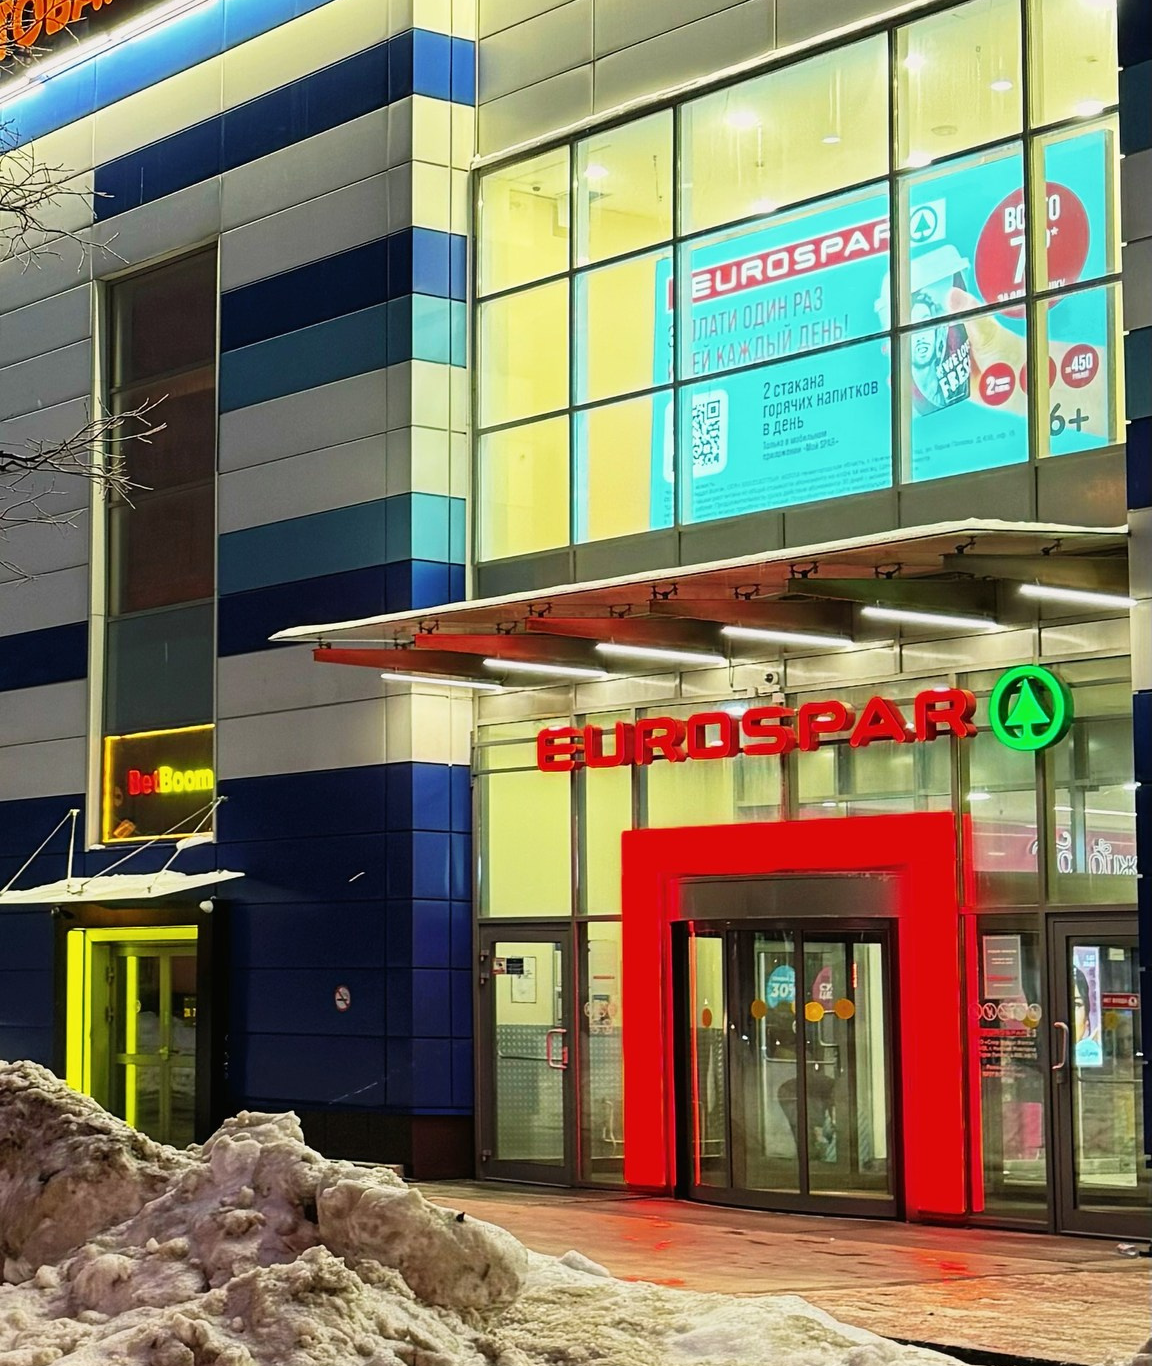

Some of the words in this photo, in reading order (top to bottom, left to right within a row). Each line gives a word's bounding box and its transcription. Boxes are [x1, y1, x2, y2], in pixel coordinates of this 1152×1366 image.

[743, 299, 788, 330] ОДИН
[793, 286, 824, 318] РАЗ
[716, 324, 792, 365] КАЖДЫЙ
[799, 314, 849, 351] ДЕНЬ!
[1071, 352, 1094, 372] 450
[763, 381, 771, 400] 2
[774, 373, 825, 398] стакана
[763, 394, 813, 419] горячих
[817, 380, 879, 407] напитков
[985, 375, 995, 396] 2
[763, 422, 770, 436] в
[772, 416, 805, 437] день
[536, 687, 978, 772] EUROSPAR
[128, 765, 214, 796] BetBoom
